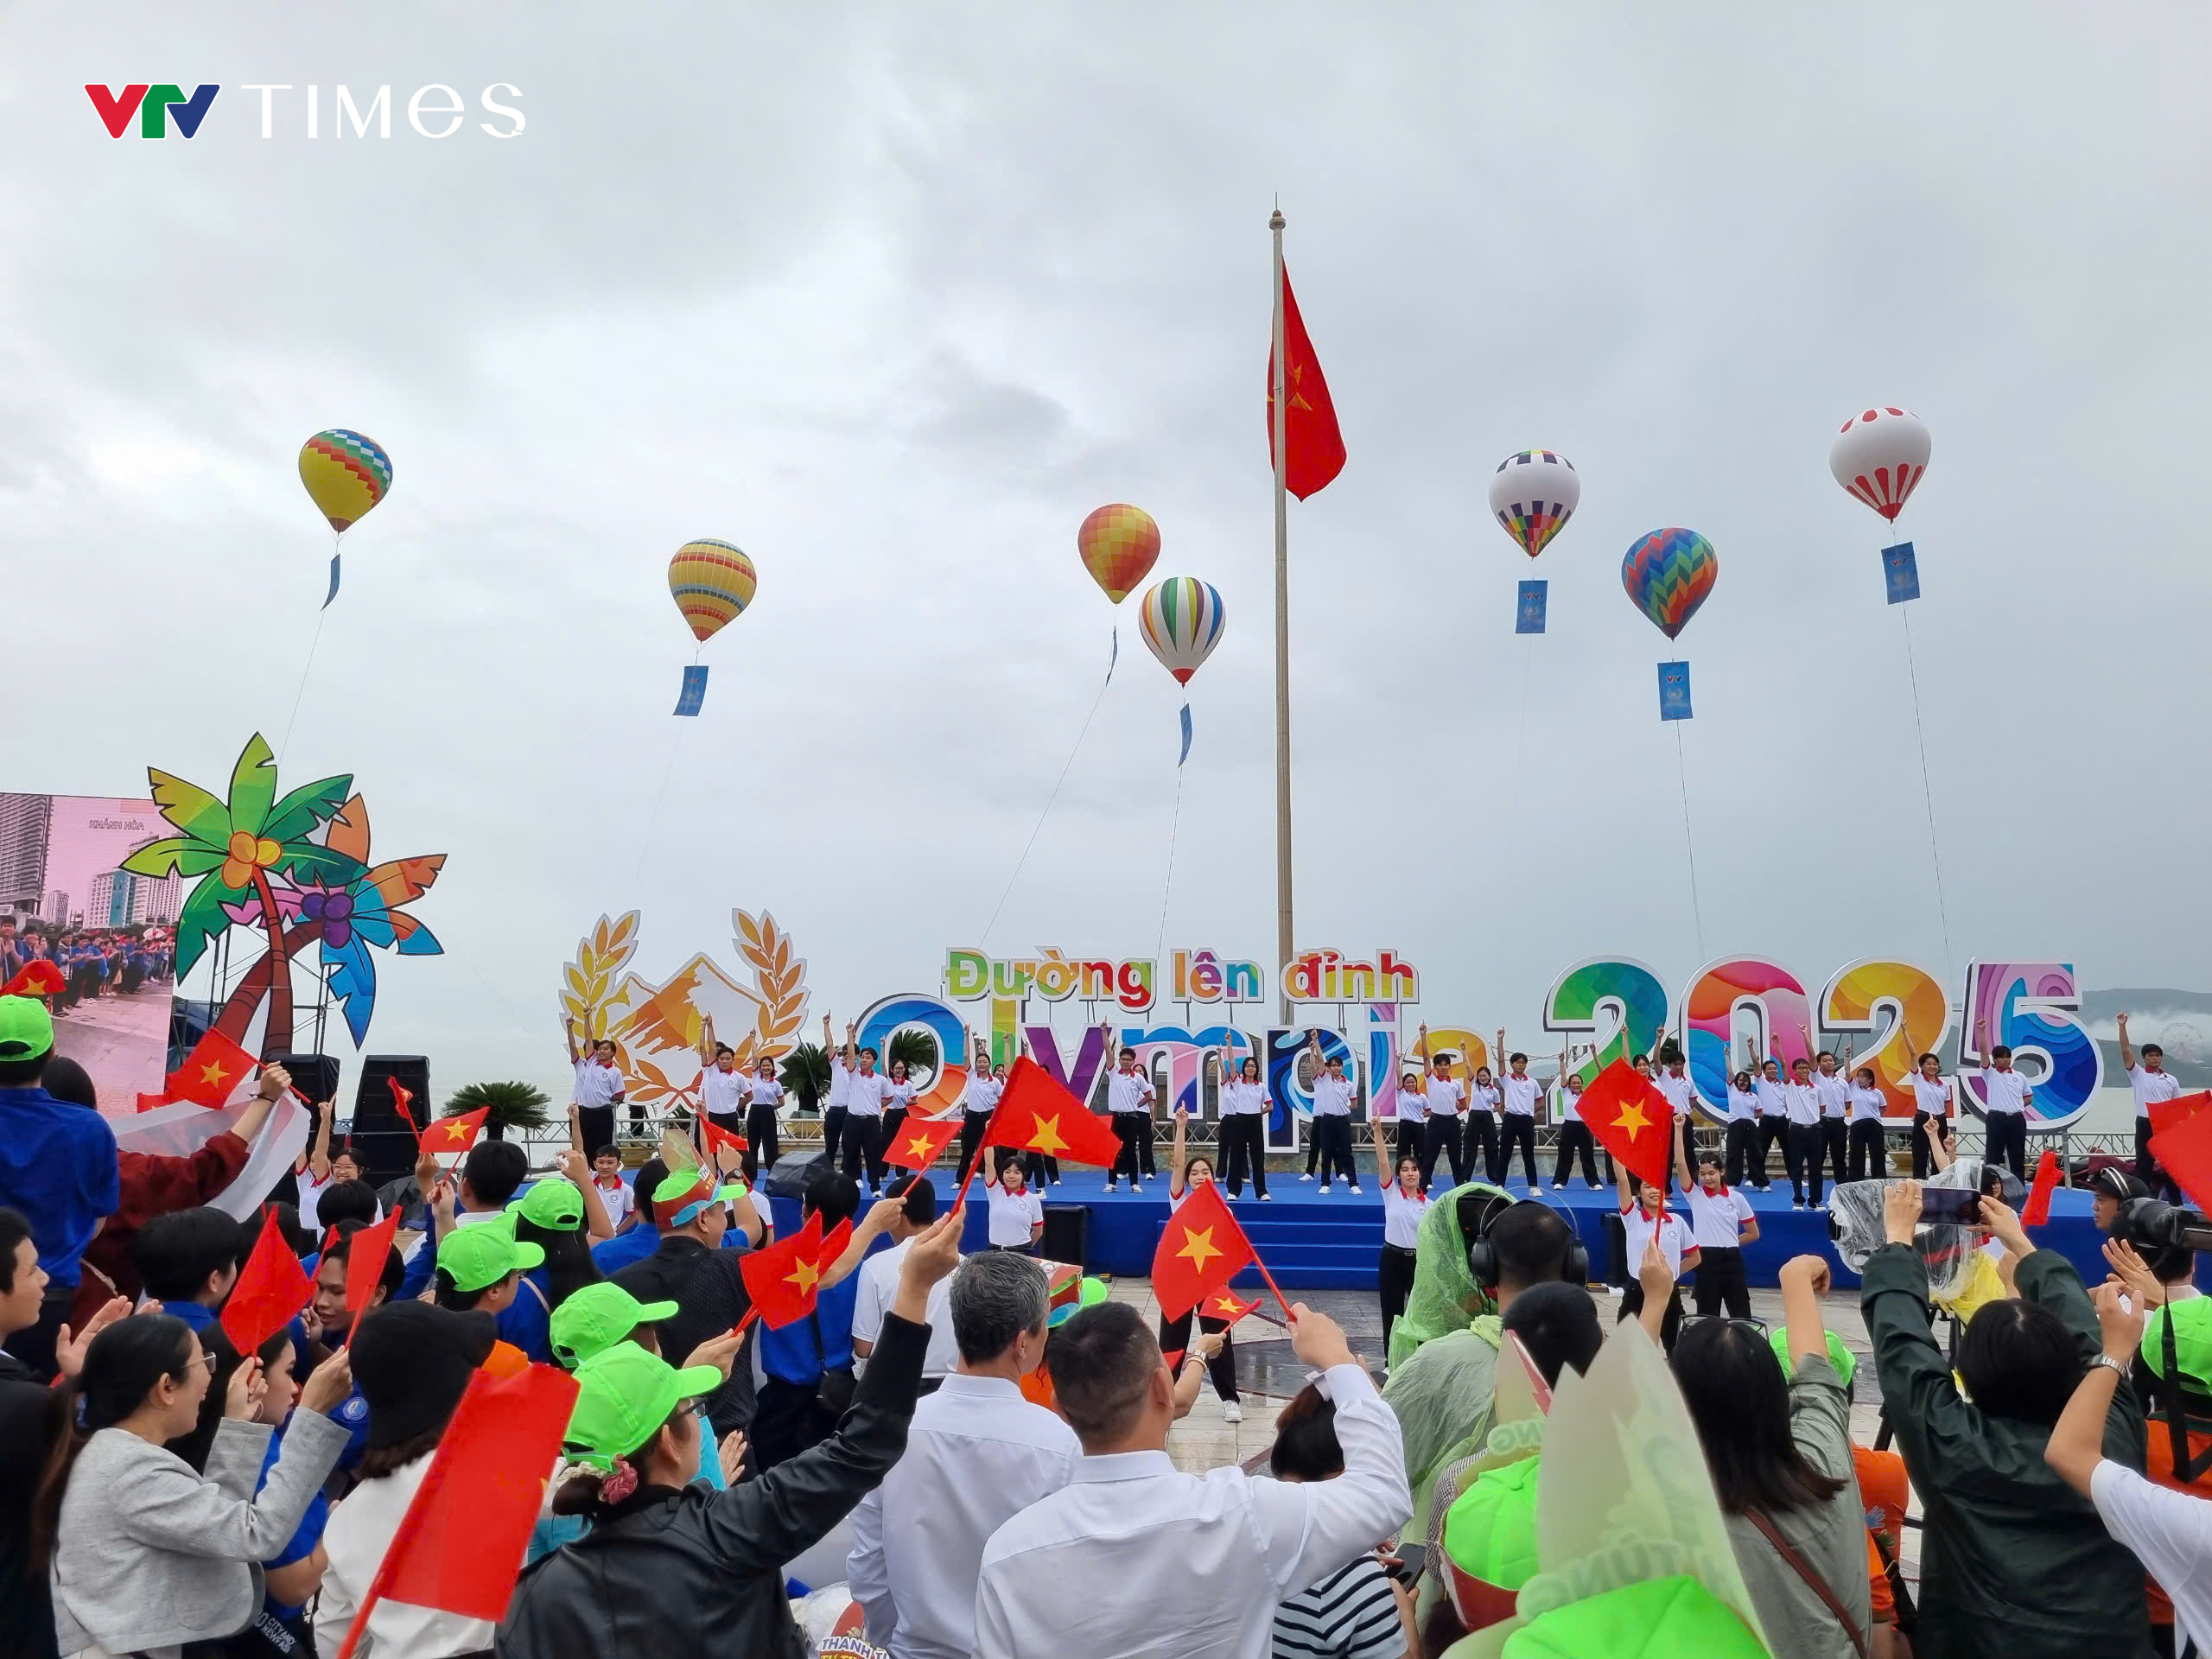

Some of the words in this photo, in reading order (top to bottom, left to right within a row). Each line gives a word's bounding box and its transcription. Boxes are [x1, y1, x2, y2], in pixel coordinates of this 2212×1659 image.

[89, 817, 122, 830] KHÁNH
[943, 947, 1154, 1010] Đường
[1172, 950, 1262, 1001] lên
[1283, 949, 1416, 1001] đỉnh
[1547, 957, 2101, 1126] 2025
[822, 1637, 872, 1659] THANH
